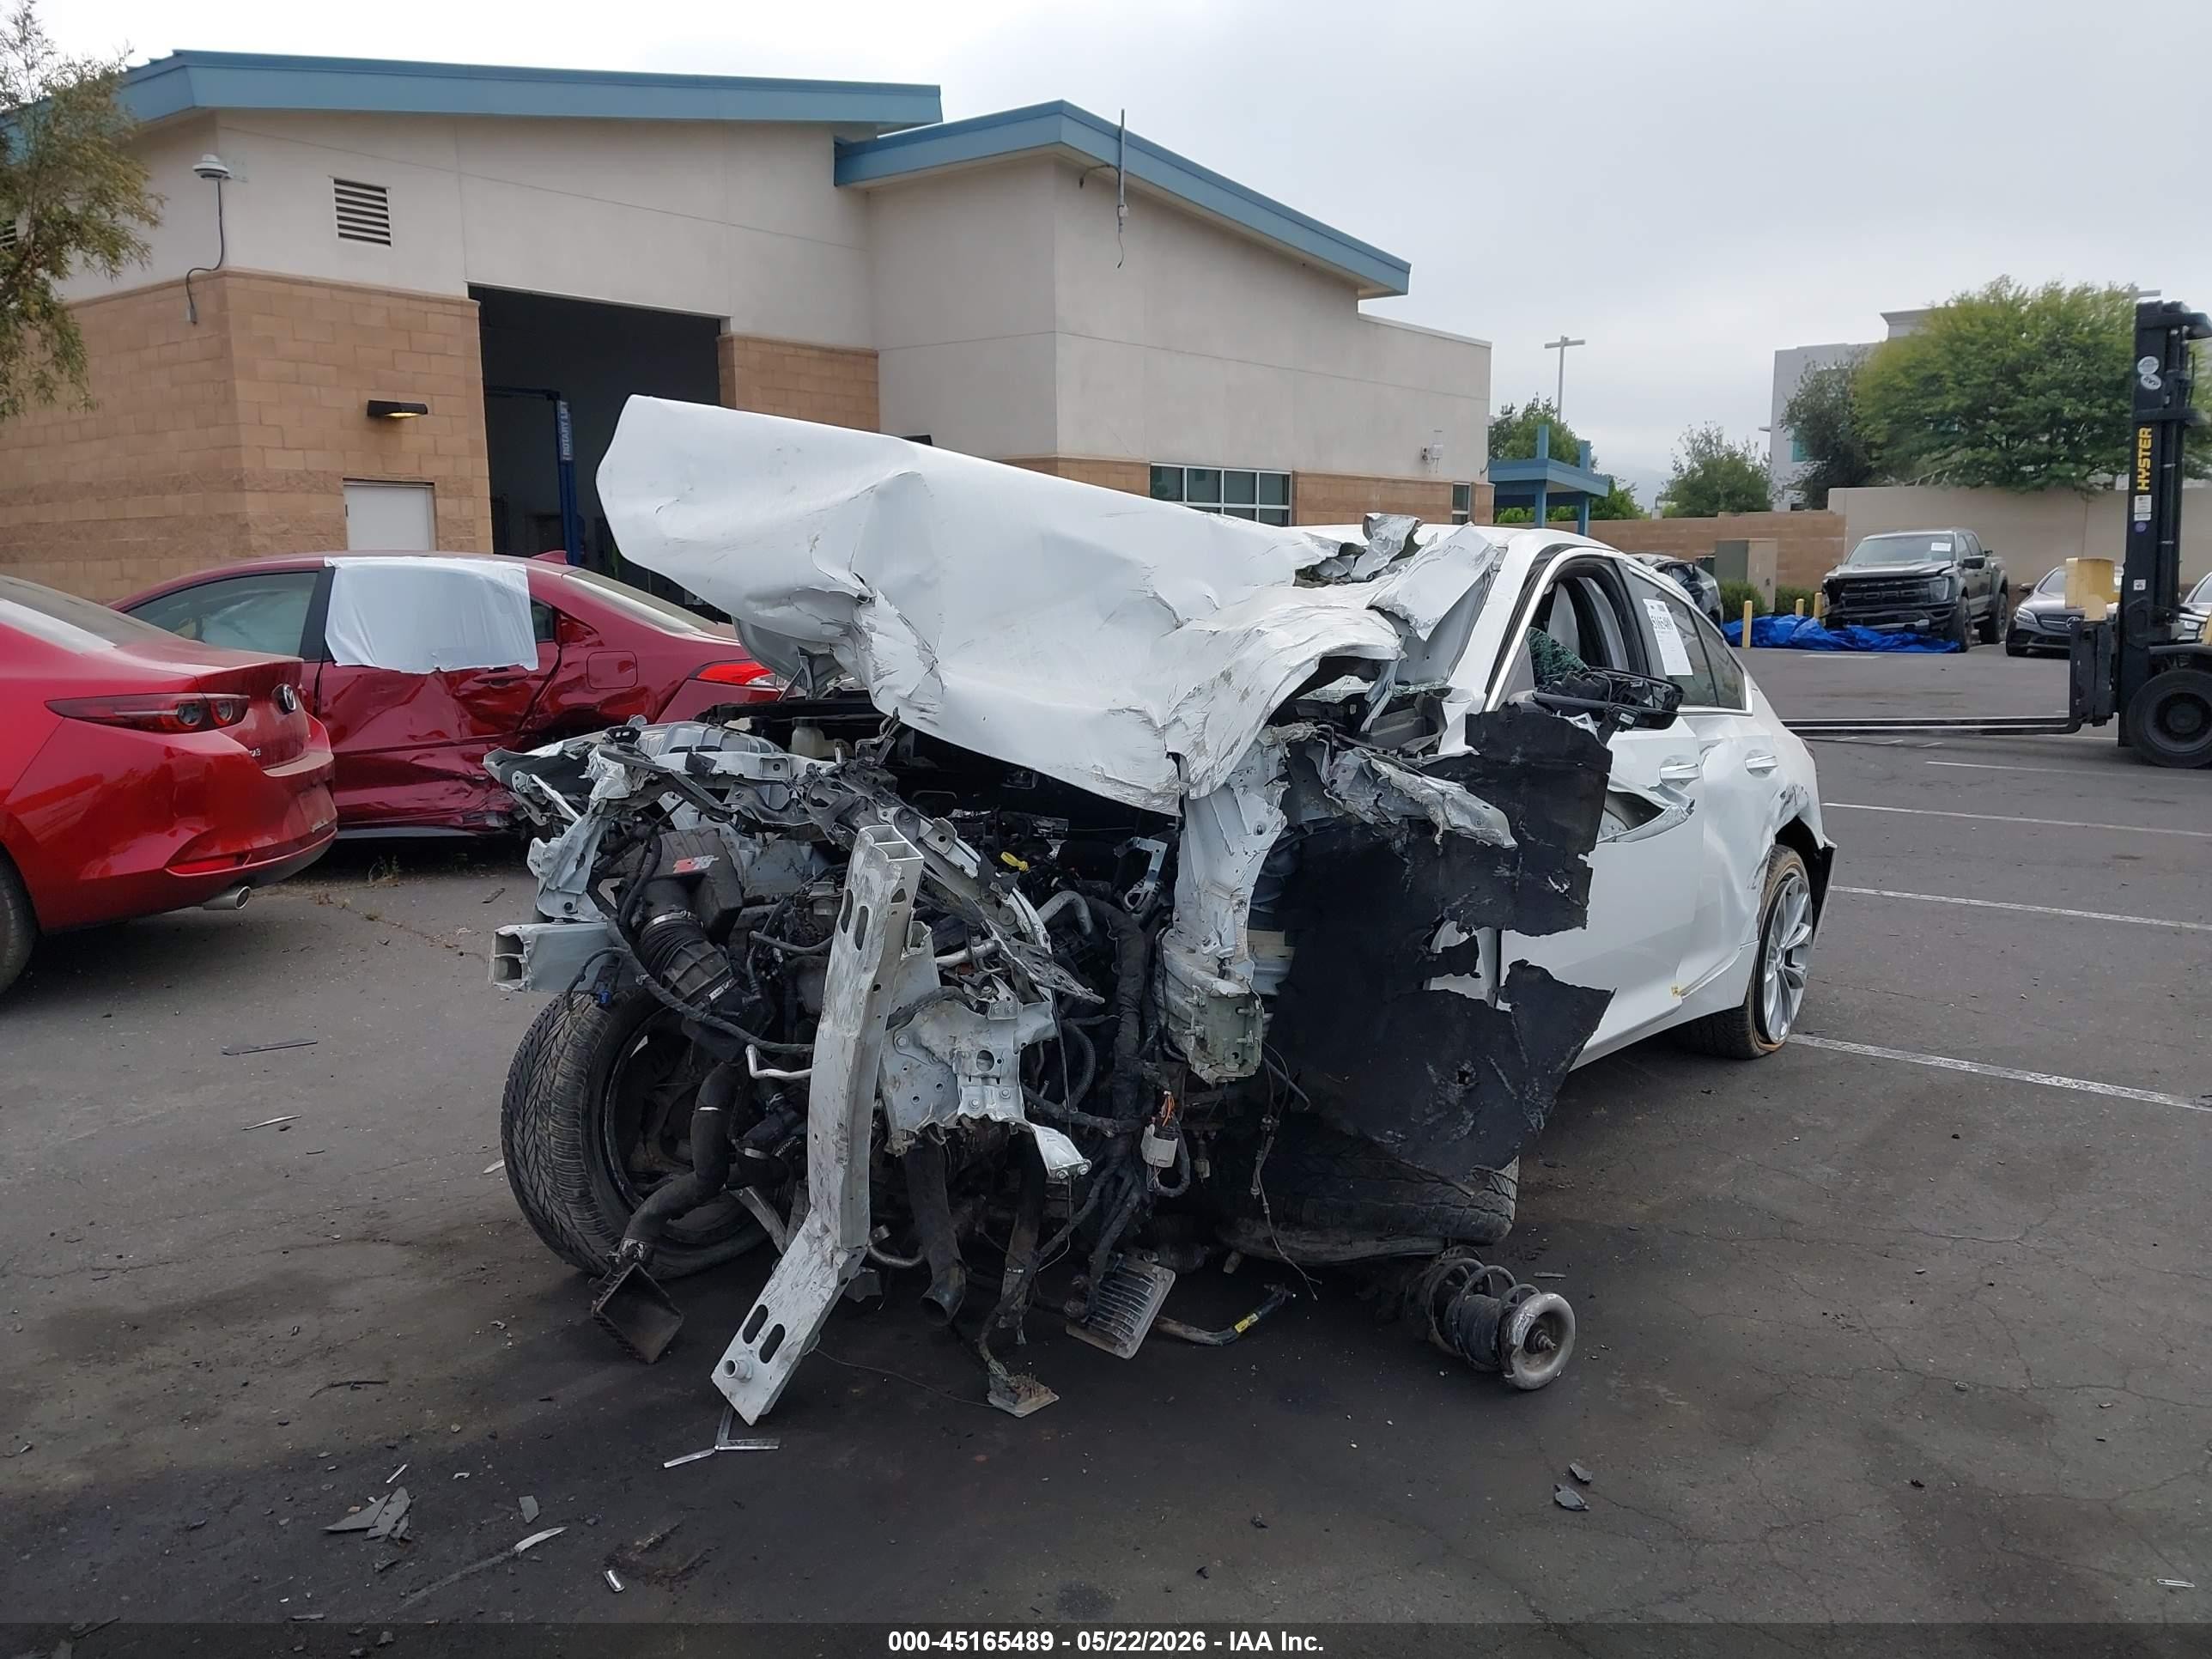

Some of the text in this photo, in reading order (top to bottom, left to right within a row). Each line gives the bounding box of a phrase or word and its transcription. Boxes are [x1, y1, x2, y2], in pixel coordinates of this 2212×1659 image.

[561, 421, 571, 456] ROTARY
[2136, 428, 2153, 490] HYSTER
[1842, 589, 1917, 601] FORD
